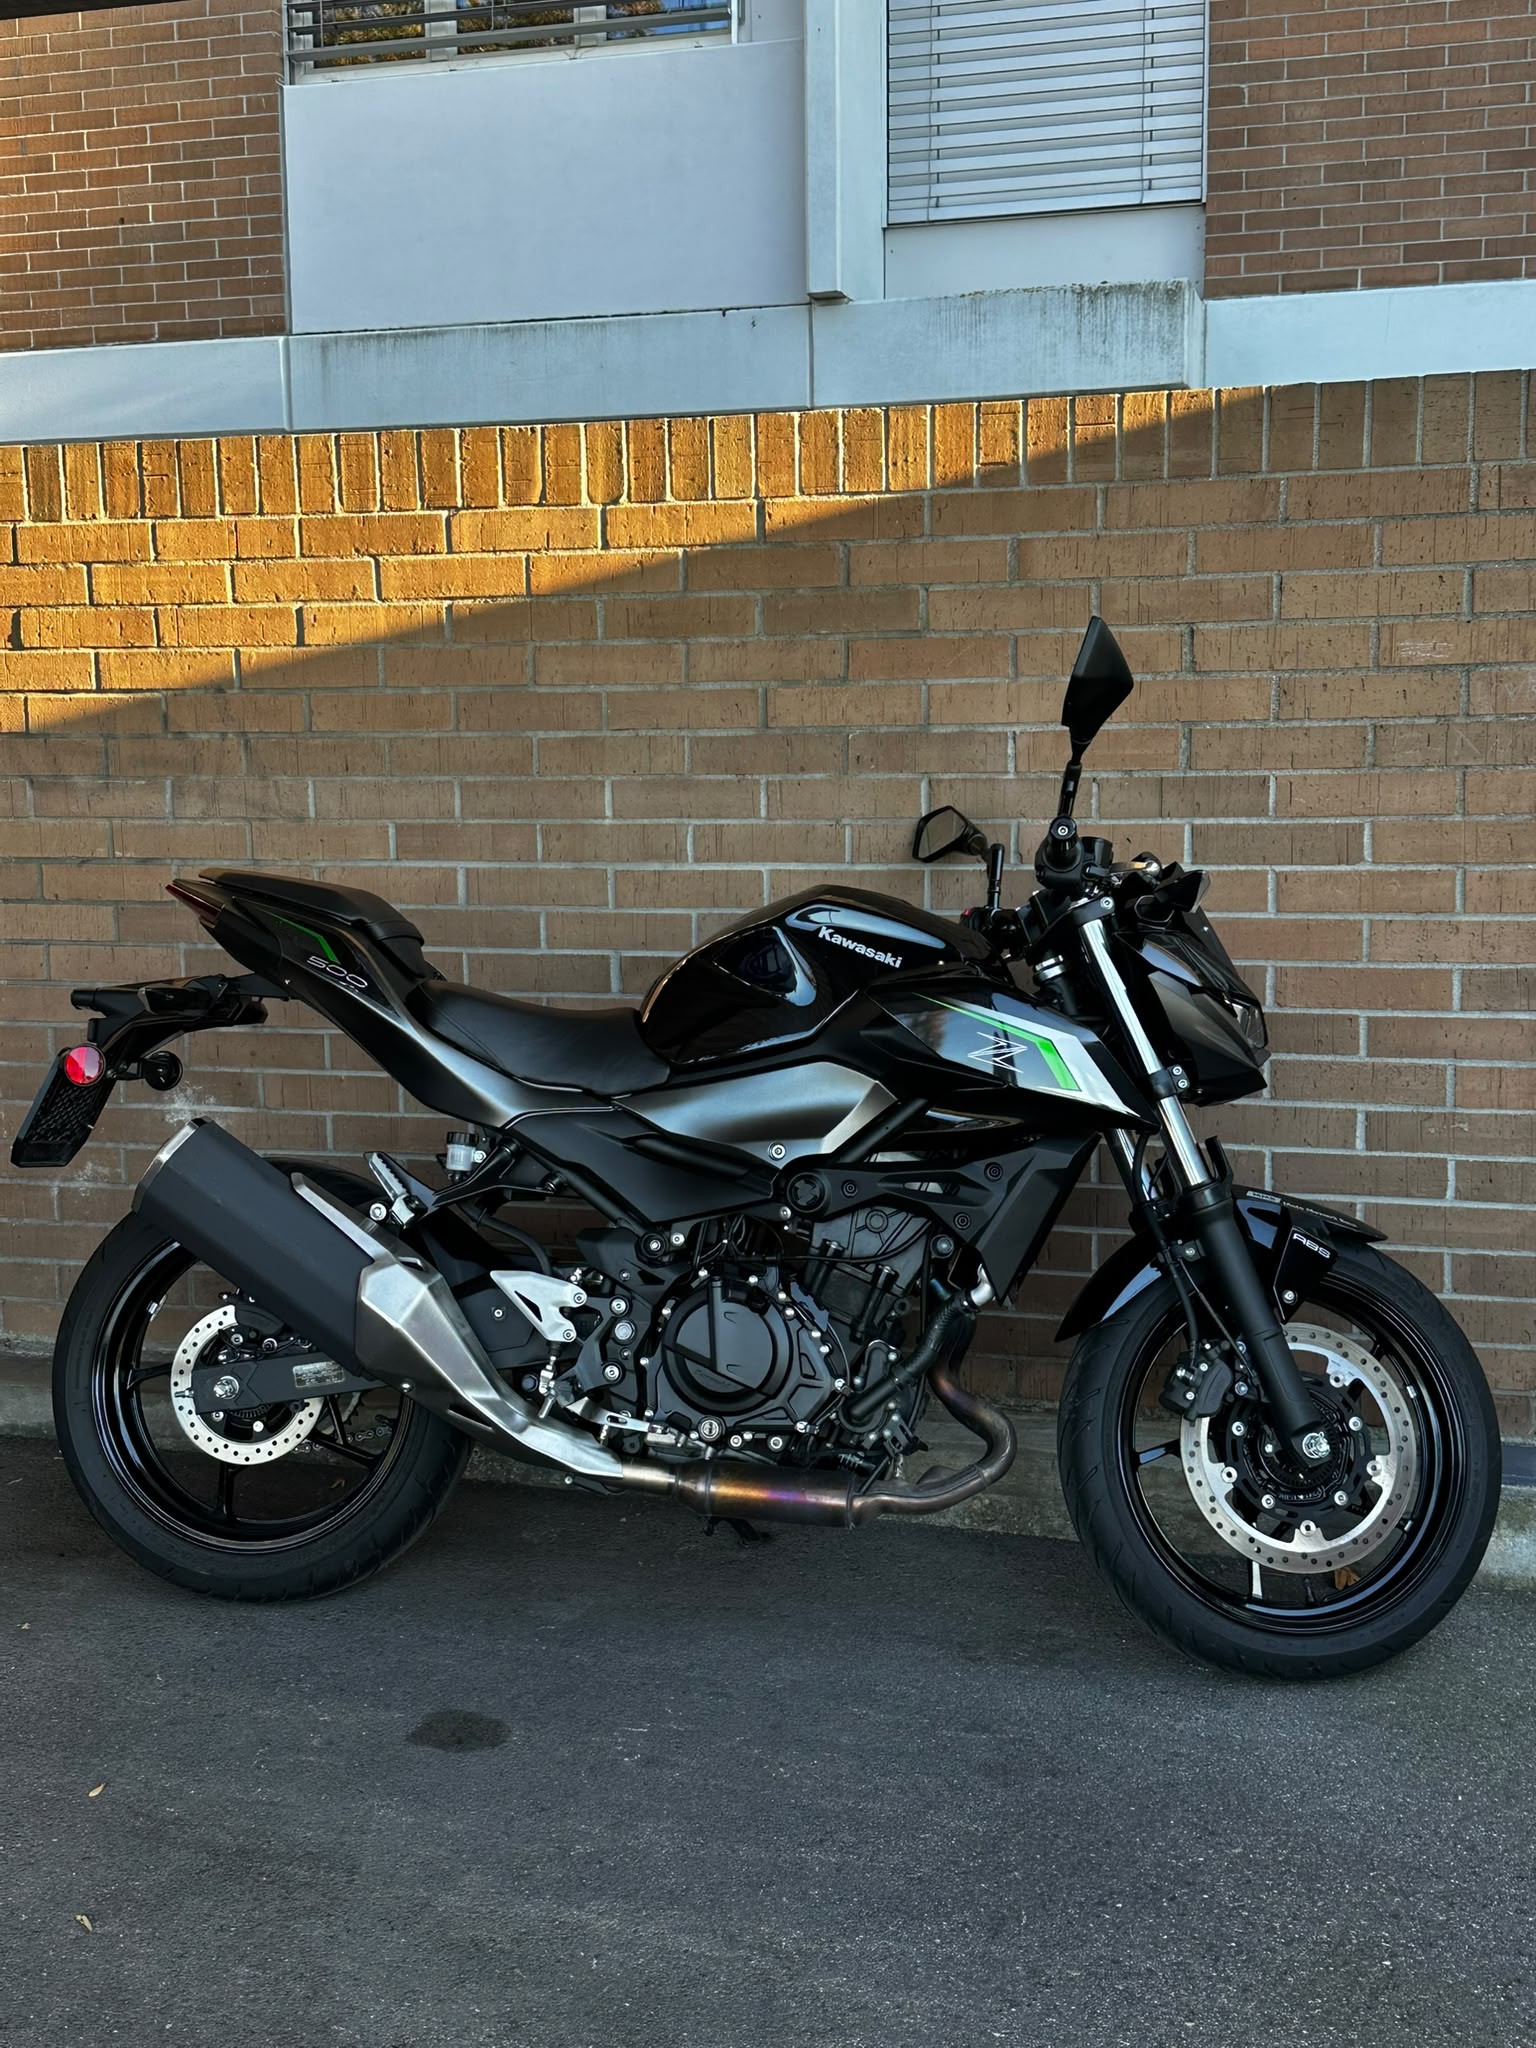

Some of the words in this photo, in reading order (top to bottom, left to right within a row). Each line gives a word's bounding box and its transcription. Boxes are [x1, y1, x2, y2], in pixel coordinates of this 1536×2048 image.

[818, 926, 903, 969] Kawasaki
[306, 955, 369, 988] 500
[1293, 1233, 1331, 1259] ABS
